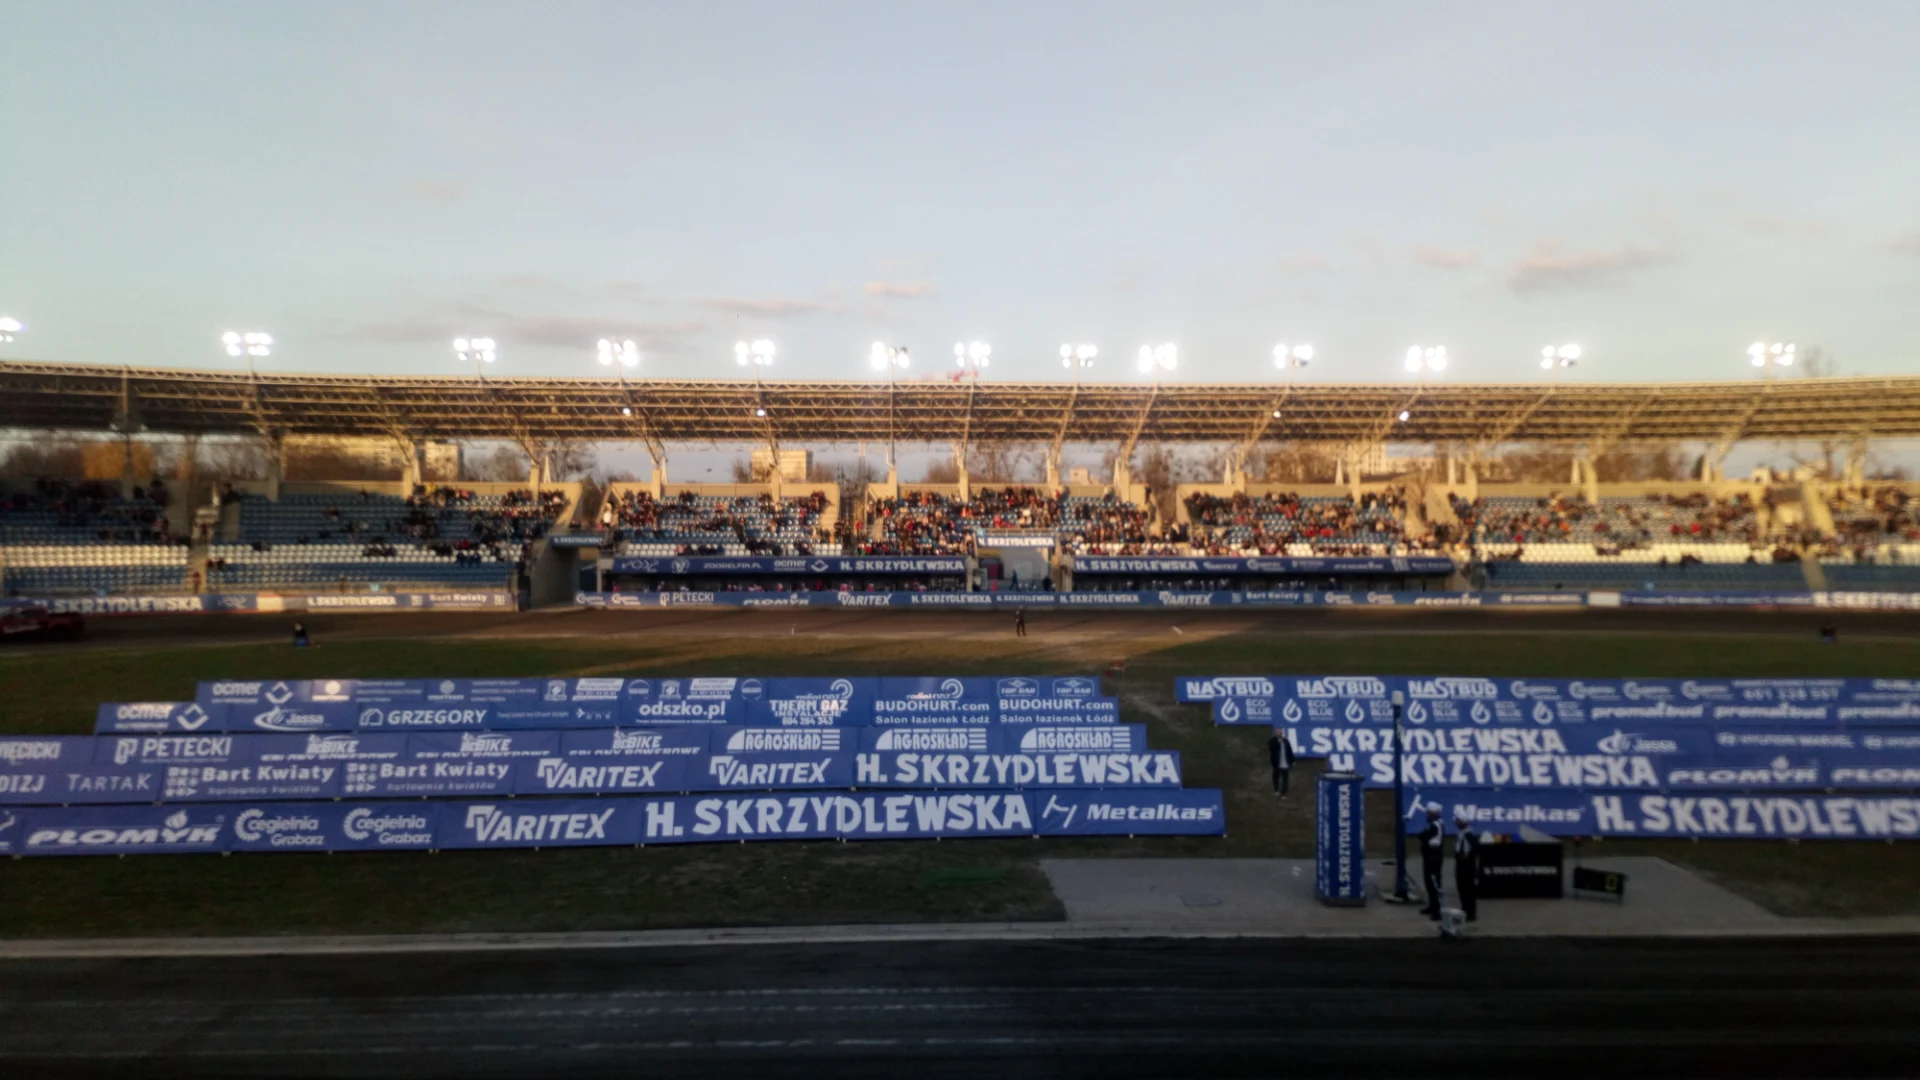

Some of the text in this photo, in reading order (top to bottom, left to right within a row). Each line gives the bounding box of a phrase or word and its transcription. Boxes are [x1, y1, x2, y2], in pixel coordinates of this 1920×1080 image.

[987, 536, 1054, 546] SKRZYDLEWSKA
[774, 560, 806, 568] ocmer
[840, 560, 965, 571] H. SKRZYDLEWSKA
[1076, 560, 1198, 571] H. SKRZYDLEWSKA
[54, 597, 203, 612] SKRZYDLEWSKA
[673, 592, 714, 602] PETECKI
[840, 593, 892, 606] VARITEX
[912, 595, 992, 603] H. SKRZYDLEWSKA
[1060, 595, 1140, 603] H. SKRZYDLEWSKA
[1160, 592, 1212, 605] VARITEX
[212, 682, 262, 695] ocmer
[1186, 678, 1274, 697] NASTBUD
[1296, 677, 1386, 697] NASTBUD
[1408, 677, 1498, 697] NASTBUD
[639, 700, 726, 719] odszko.pl
[769, 700, 849, 711] THERM GAZ
[875, 700, 990, 711] BUDOHURT.com
[1000, 699, 1114, 710] BUDOHURT.com
[1246, 706, 1272, 715] BLUE
[1308, 707, 1334, 716] BLUE
[116, 705, 174, 720] ocmer
[286, 713, 324, 724] Jassa
[388, 710, 487, 725] GRZEGORY
[875, 715, 908, 724] Salon
[912, 715, 958, 724] łazienek
[1000, 714, 1032, 723] Salon
[1036, 714, 1082, 722] łazienek
[142, 737, 232, 757] PETECKI
[745, 733, 822, 750] AGROSKŁAD
[894, 733, 968, 750] AGROSKŁAD
[1037, 731, 1112, 749] AGROSKŁAD
[1311, 727, 1567, 753] SKRZYDLEWSKA
[202, 764, 335, 783] Bart Kwiaty
[380, 761, 510, 779] Bart Kwiaty
[539, 758, 664, 788] VARITEX
[711, 756, 832, 785] VARITEX
[856, 752, 1180, 784] H. SKRZYDLEWSKA
[1370, 752, 1659, 787] SKRZYDLEWSKA
[67, 773, 153, 792] TARTAK
[645, 794, 1033, 837] H. SKRZYDLEWSKA
[1087, 803, 1213, 821] Metalkas
[1592, 796, 1920, 836] H. SKRZYDLEWS
[468, 805, 615, 842] VARITEX
[271, 832, 325, 846] Grabarz
[379, 831, 432, 845] Grabarz
[1338, 784, 1351, 883] SKRZYDLEWSKA
